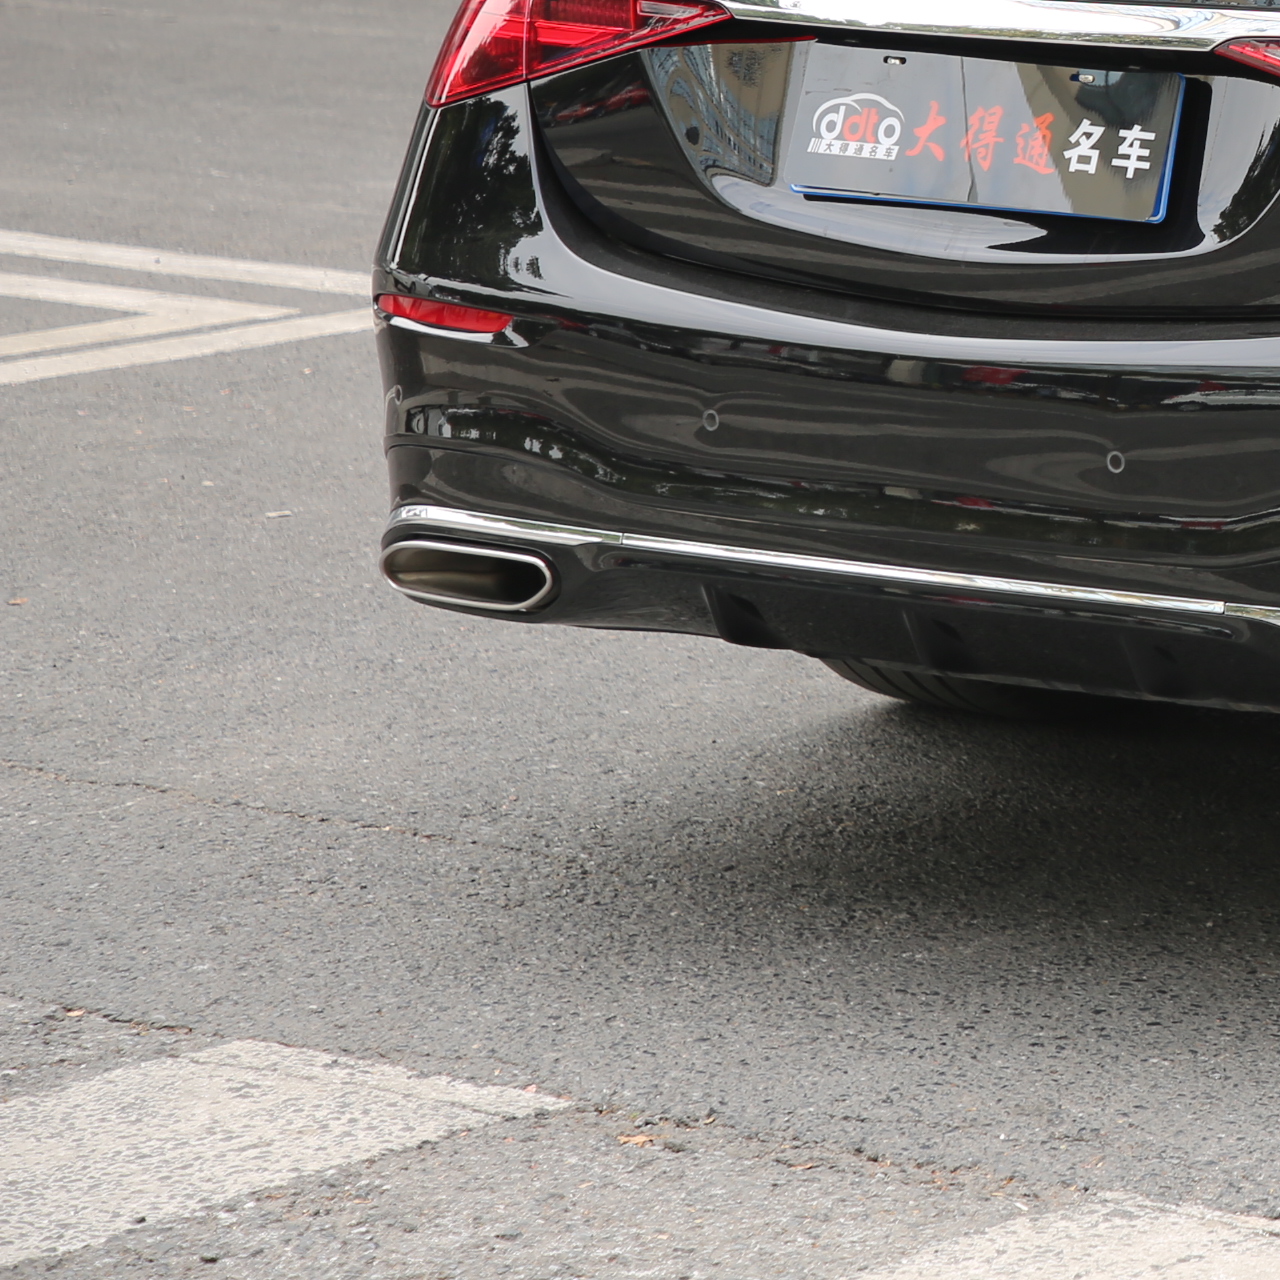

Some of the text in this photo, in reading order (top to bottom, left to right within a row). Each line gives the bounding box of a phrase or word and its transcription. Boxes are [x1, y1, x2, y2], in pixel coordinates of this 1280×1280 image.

[823, 141, 895, 159] 大得通名车
